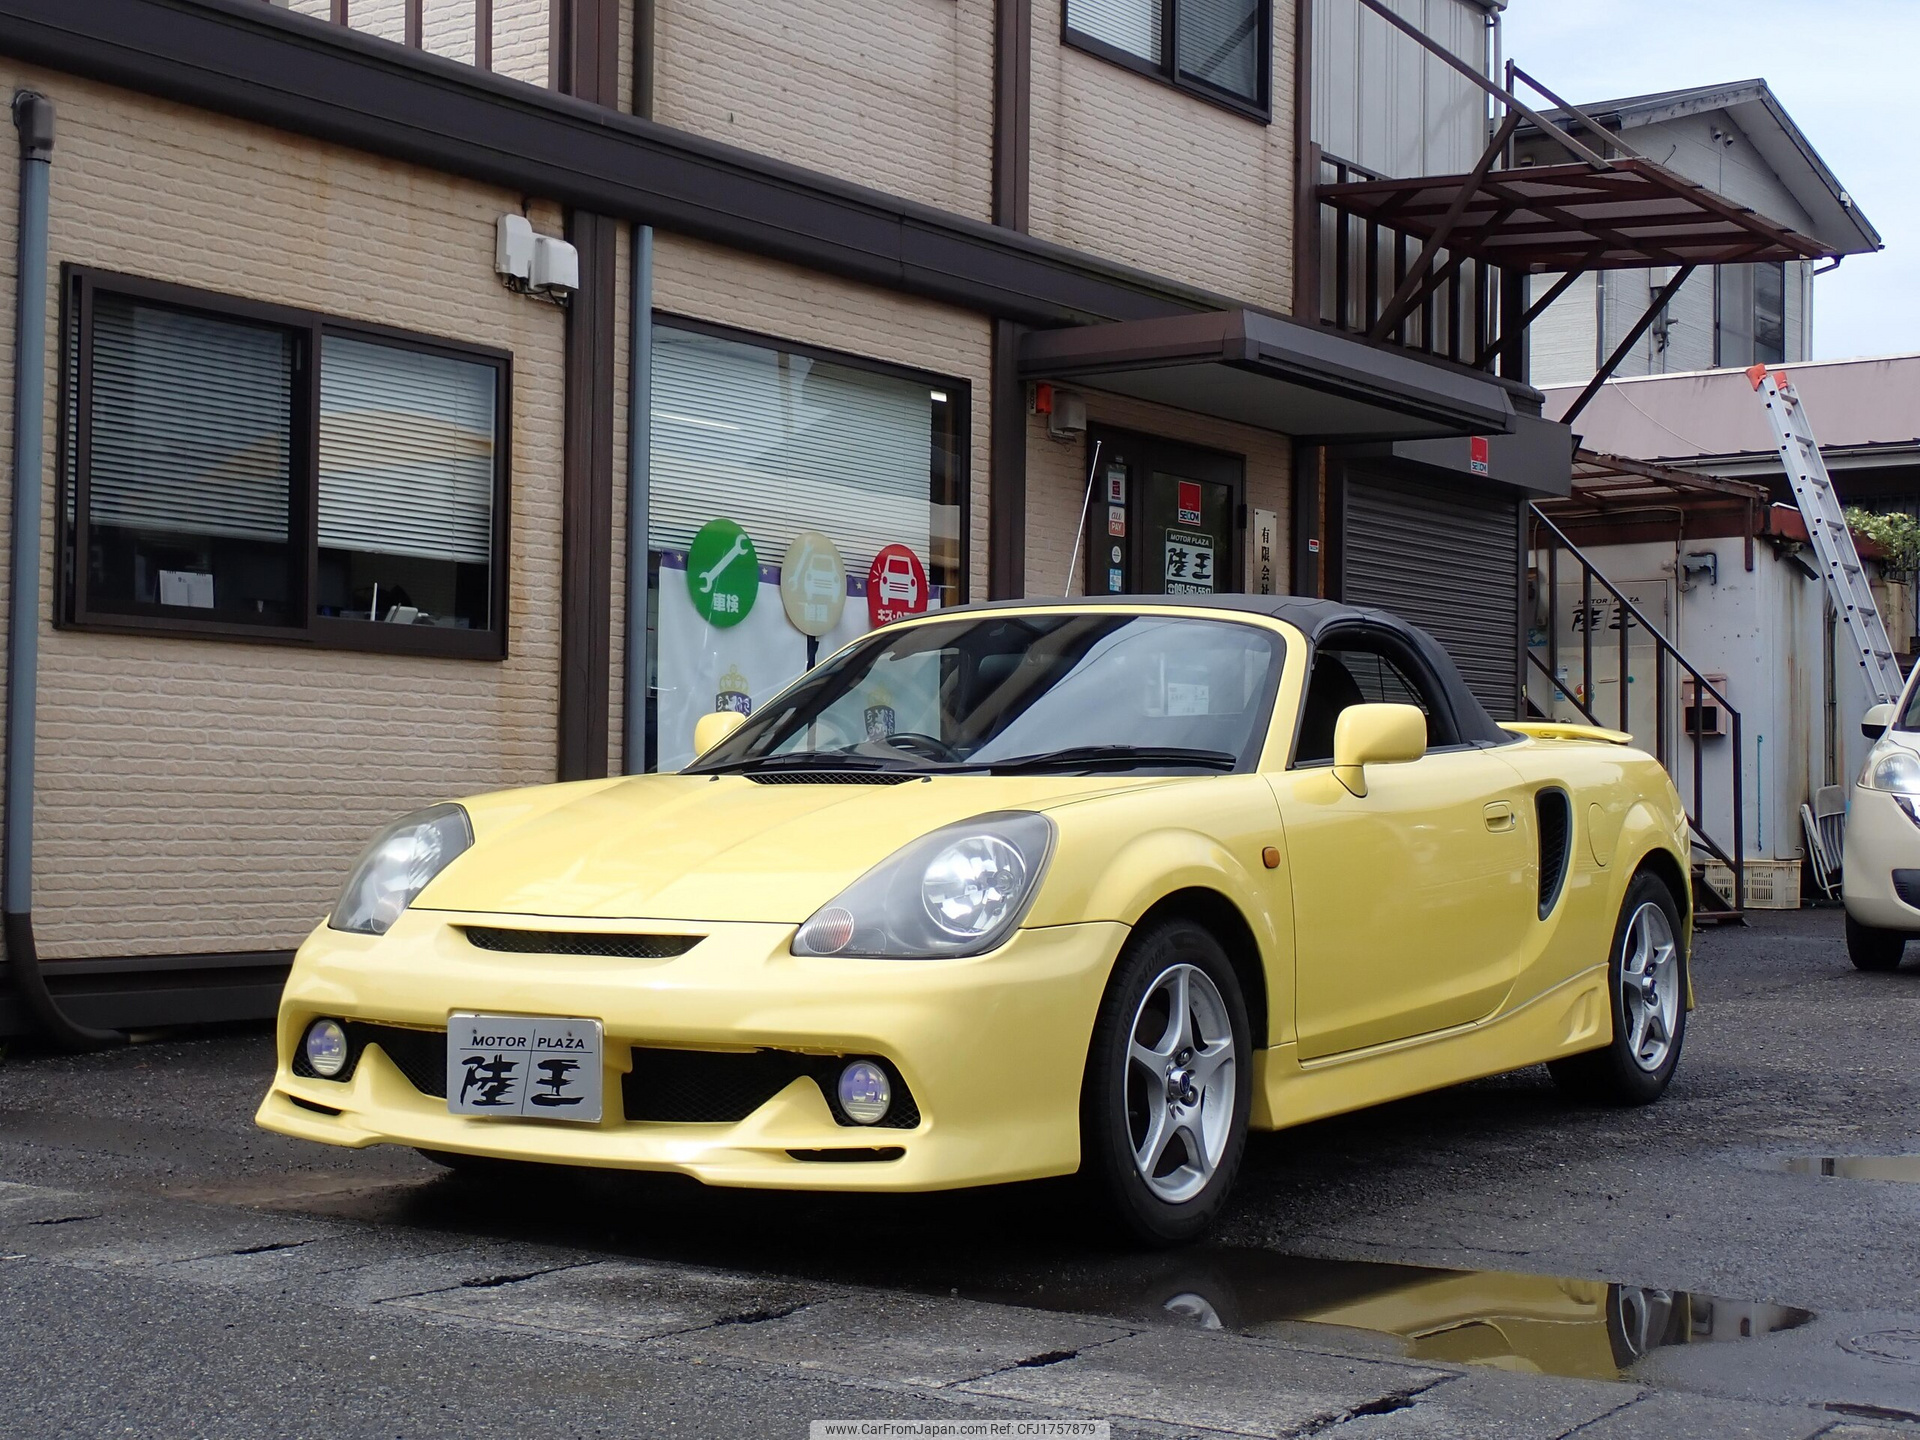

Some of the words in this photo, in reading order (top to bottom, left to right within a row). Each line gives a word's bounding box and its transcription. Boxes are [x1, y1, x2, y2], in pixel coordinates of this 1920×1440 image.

[1179, 510, 1200, 522] SECOM
[1111, 521, 1122, 532] PAY
[1170, 533, 1191, 543] MOTOR
[1191, 536, 1210, 546] PLAZA
[713, 592, 739, 613] 車検
[1613, 596, 1640, 604] PZA
[877, 608, 912, 622] キズ・ヘ
[472, 1035, 527, 1048] MOTOR
[537, 1037, 585, 1049] PLAZA
[459, 1053, 585, 1107] 陸王
